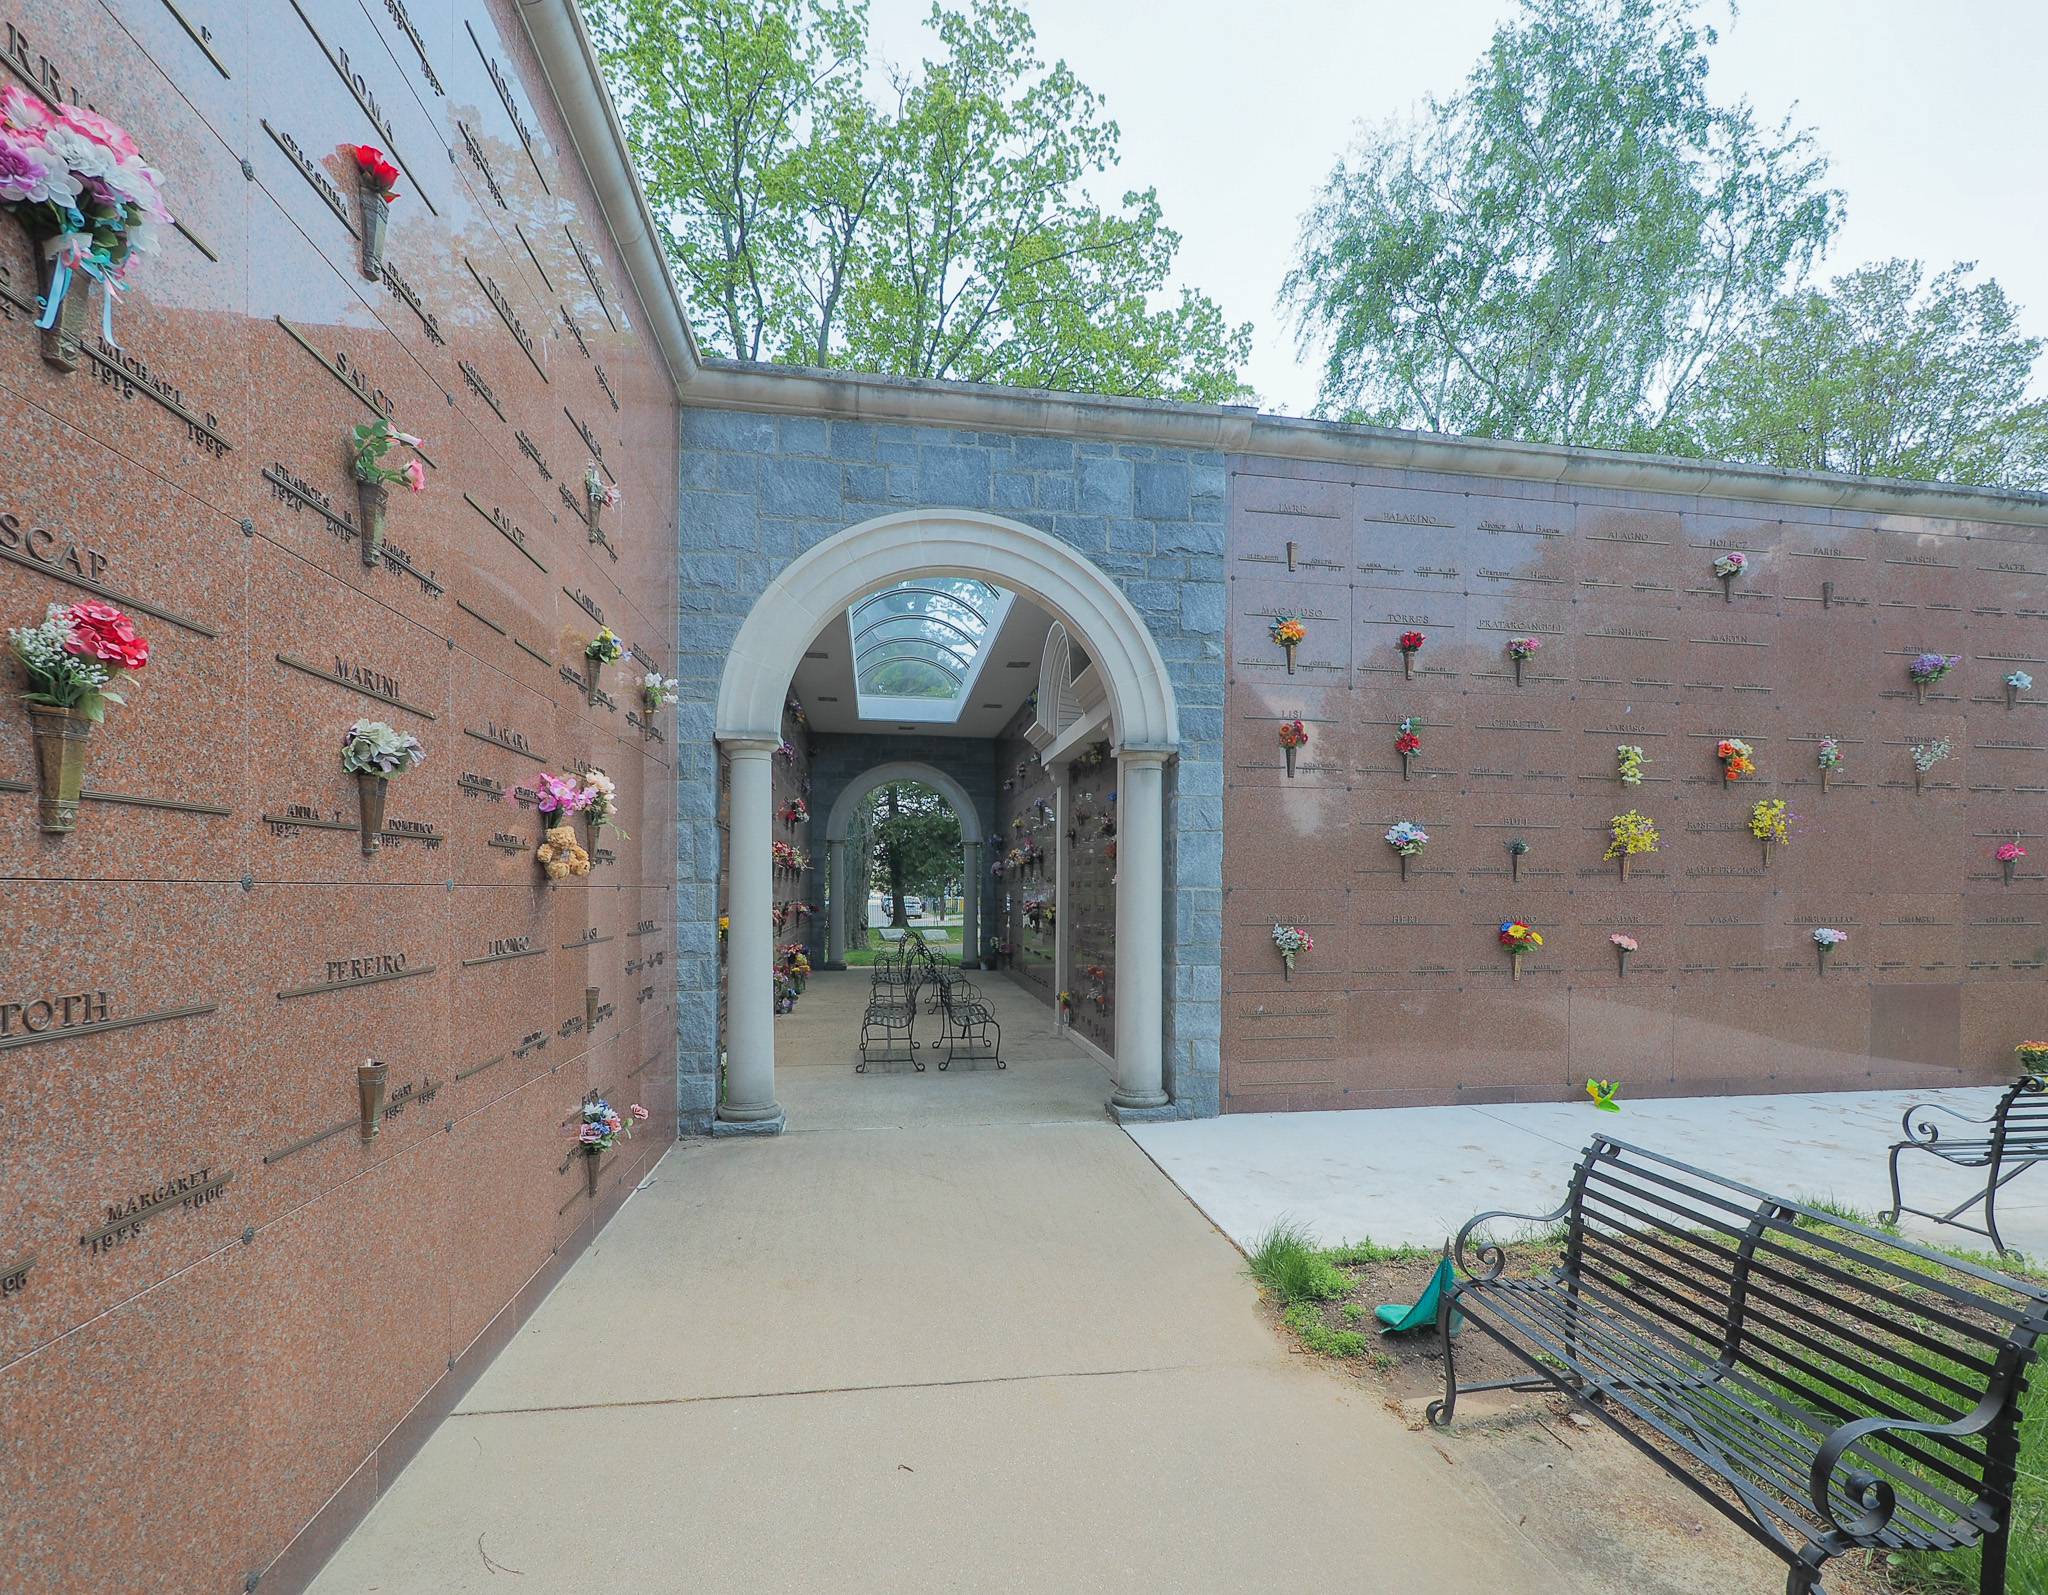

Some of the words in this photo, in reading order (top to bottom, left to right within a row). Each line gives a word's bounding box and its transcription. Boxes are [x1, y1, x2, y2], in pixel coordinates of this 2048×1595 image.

[339, 47, 395, 145] ROMA
[487, 276, 533, 352] TEDESCO
[91, 359, 135, 400] 1918
[99, 336, 187, 410] MICHAEL
[206, 412, 219, 431] D
[336, 351, 395, 416] SALCE
[271, 481, 303, 513] 1920
[1387, 613, 1430, 624] TORRES
[334, 655, 401, 701] MARINI
[1281, 709, 1303, 720] LISI
[286, 804, 321, 822] ANNA
[488, 935, 531, 957] LUONGO
[326, 952, 407, 984] PEREIRO
[0, 991, 110, 1039] TOTH
[107, 1166, 213, 1222] MARGARET
